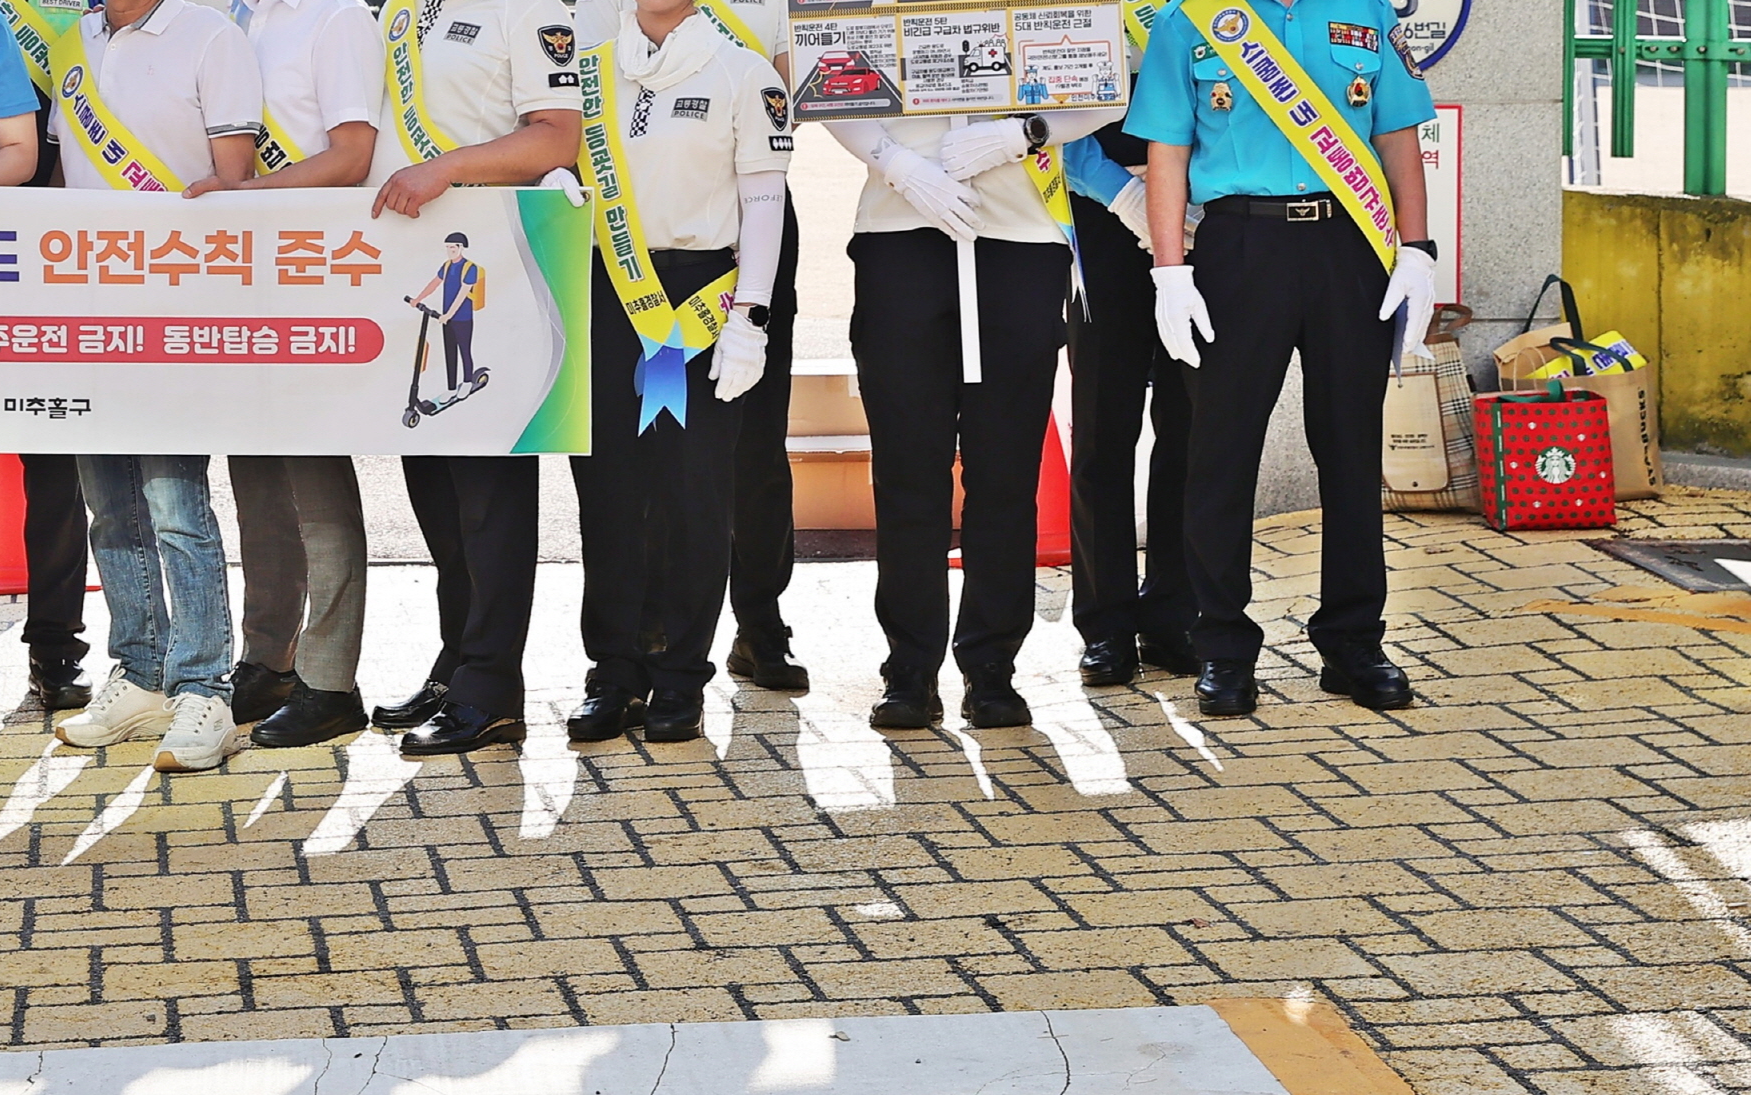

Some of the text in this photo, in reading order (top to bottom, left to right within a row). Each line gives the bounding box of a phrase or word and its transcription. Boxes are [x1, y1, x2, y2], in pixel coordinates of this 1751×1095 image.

[58, 0, 81, 8] DRIVER
[904, 26, 931, 37] 비긴급
[933, 25, 961, 36] 구급차
[1033, 19, 1071, 31] 반칙운전
[445, 34, 474, 44] POLICE
[795, 31, 846, 46] 끼어들기
[1239, 41, 1301, 104] 스쿨존
[1289, 99, 1320, 127] 내
[673, 110, 706, 120] POLICE
[605, 205, 644, 283] 만들기
[39, 229, 253, 287] 안전수칙
[274, 229, 383, 287] 준수
[77, 324, 145, 355] 금지!
[163, 323, 280, 355] 동반탑승
[288, 324, 357, 355] 금지!
[4, 396, 92, 420] 미추홀구
